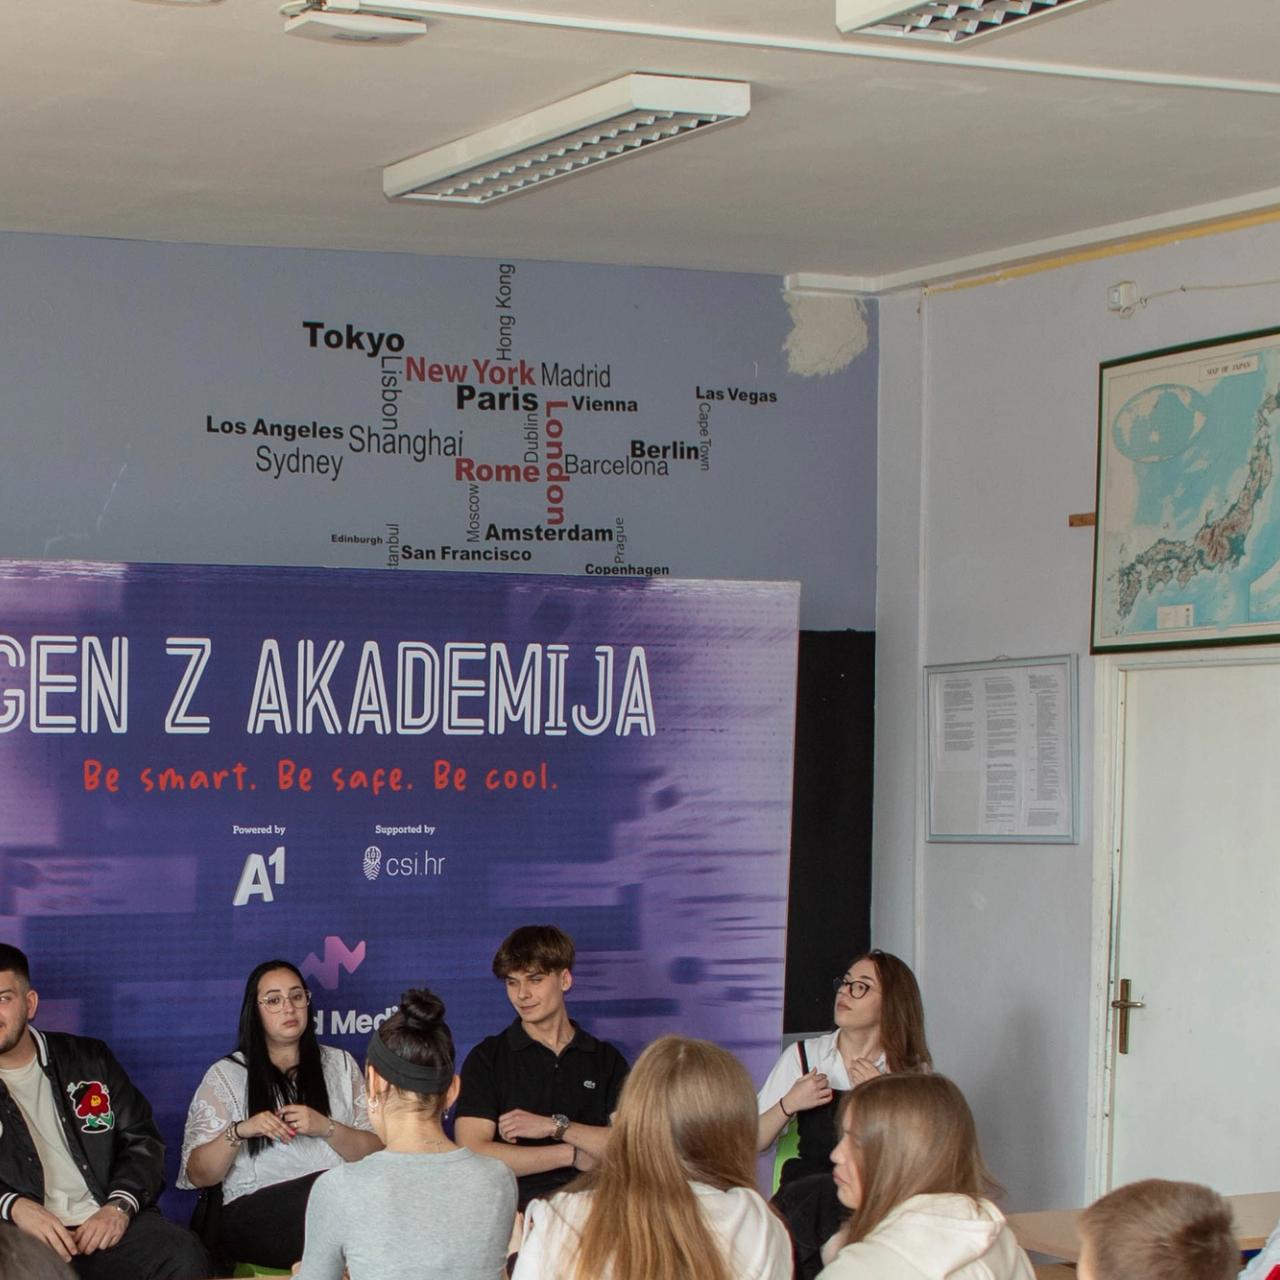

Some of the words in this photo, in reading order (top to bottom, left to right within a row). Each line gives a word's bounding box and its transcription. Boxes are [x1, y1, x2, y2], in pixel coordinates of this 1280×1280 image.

[495, 263, 516, 309] Kong
[302, 321, 405, 358] Tokyo
[496, 315, 516, 361] Hong
[406, 356, 468, 383] New
[472, 359, 536, 386] York
[541, 362, 611, 388] Madrid
[381, 356, 403, 431] Lisbon
[456, 385, 539, 412] Paris
[571, 395, 638, 412] Vienna
[696, 385, 724, 400] Las
[728, 387, 778, 405] Vegas
[206, 415, 247, 434] Los
[252, 418, 345, 441] Angeles
[697, 402, 711, 437] Cape
[348, 424, 464, 462] Shanghai
[523, 412, 539, 463] Dublin
[630, 439, 700, 460] Berlin
[255, 445, 344, 481] Sydney
[455, 457, 541, 482] Rome
[545, 400, 570, 525] London
[564, 454, 670, 476] Barcelona
[699, 438, 712, 471] Town
[466, 483, 480, 543] Moscow
[331, 534, 383, 546] Edinburgh
[385, 523, 399, 570] tanbul
[484, 523, 614, 542] Amsterdam
[614, 517, 627, 564] Prague
[401, 545, 436, 560] San
[440, 546, 532, 562] Francisco
[585, 563, 670, 577] Copenhagen
[164, 637, 212, 734] Z
[246, 639, 656, 736] AKADEMIJA
[83, 759, 120, 792] Be
[140, 762, 257, 792] smart.
[277, 759, 313, 792] Be
[331, 767, 413, 796] safe.
[433, 759, 467, 792] Be
[485, 762, 558, 790] cool.
[232, 825, 272, 835] Powered
[274, 825, 286, 836] by
[375, 825, 422, 836] Supported
[424, 825, 436, 836] by
[232, 846, 286, 907] A1
[385, 850, 446, 877] csi.hr
[331, 1005, 399, 1035] Med
